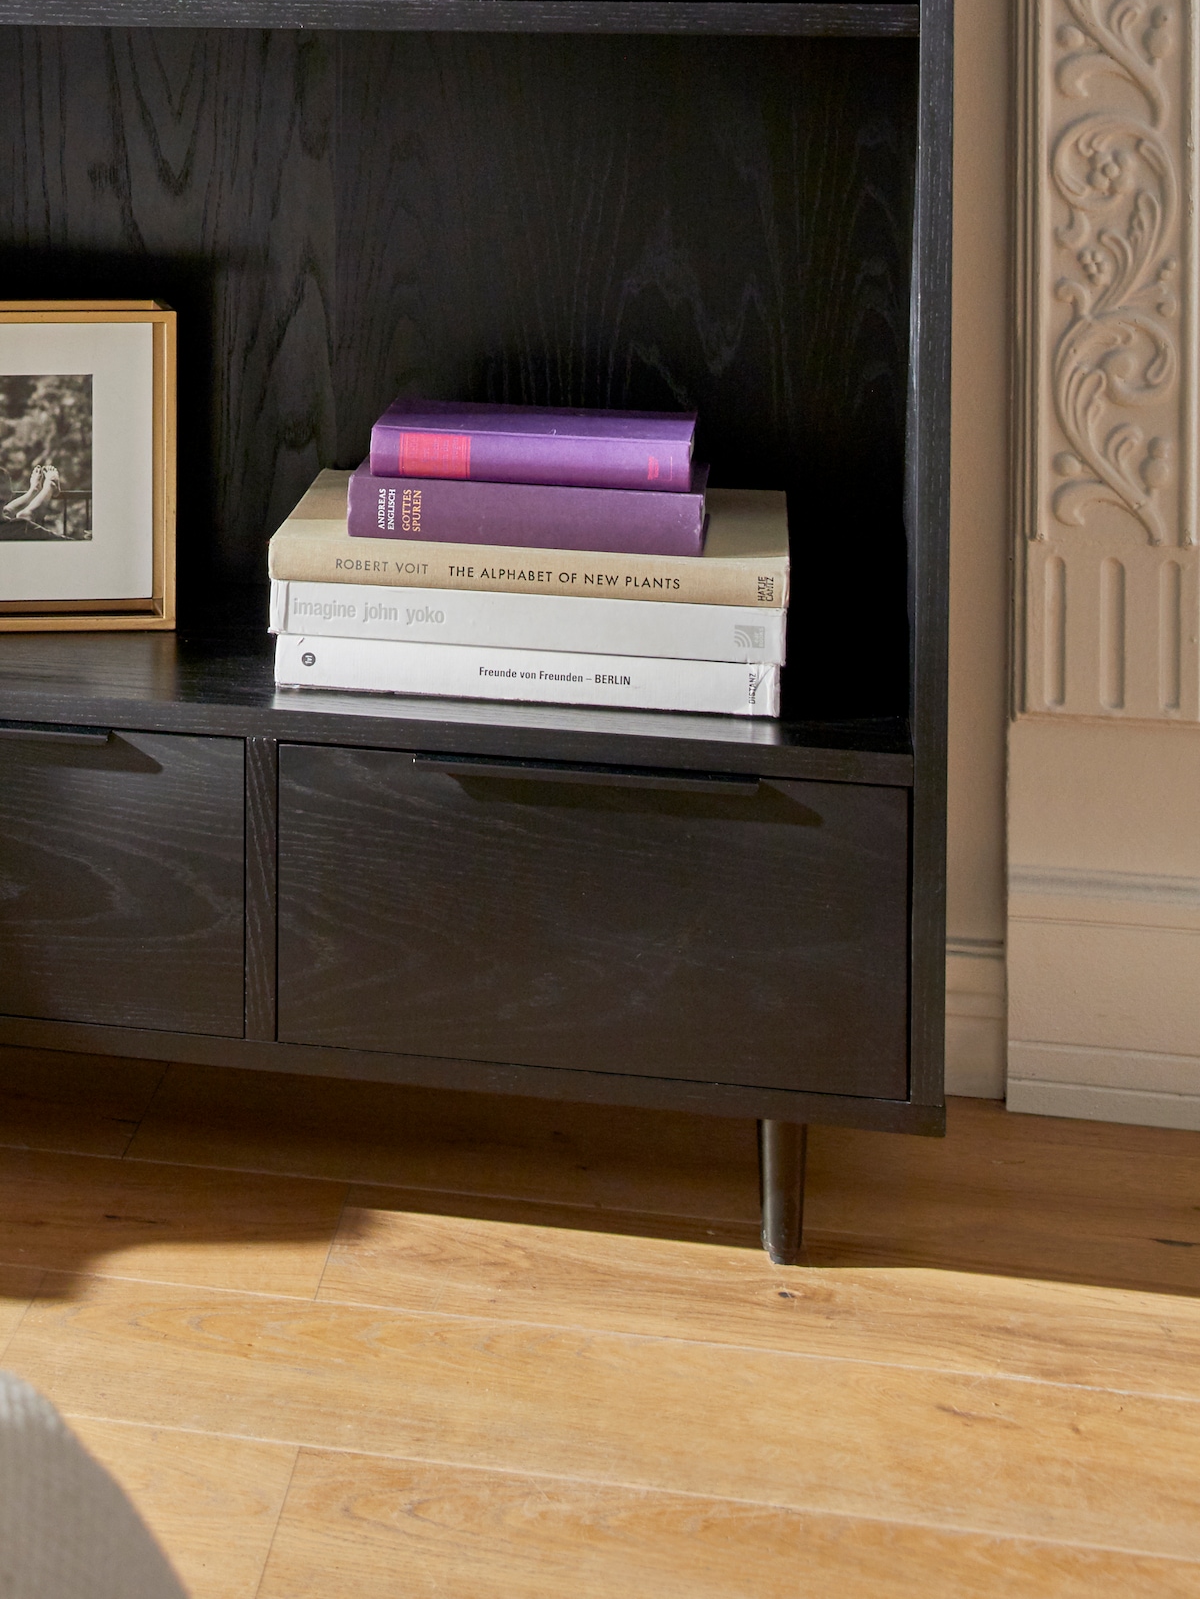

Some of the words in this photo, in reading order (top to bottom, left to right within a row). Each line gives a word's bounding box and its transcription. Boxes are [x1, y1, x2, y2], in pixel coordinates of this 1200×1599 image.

[378, 488, 387, 530] ANDREAS
[387, 489, 396, 530] ENGLISCH
[402, 489, 412, 531] GOTTES
[412, 489, 422, 532] SPUREN
[335, 558, 389, 572] ROBERT
[395, 562, 429, 575] VOIT
[448, 565, 474, 578] THE
[480, 567, 553, 582] ALPHABET
[558, 572, 578, 584] OF
[584, 573, 619, 586] NEW
[625, 576, 681, 590] PLANTS
[757, 576, 767, 601] HATJE
[293, 597, 357, 620] imagine
[363, 602, 399, 623] john
[406, 606, 446, 625] yoko
[479, 667, 517, 679] Freunde
[519, 670, 536, 680] von
[539, 670, 584, 683] Freunden
[594, 674, 631, 686] BERLIN
